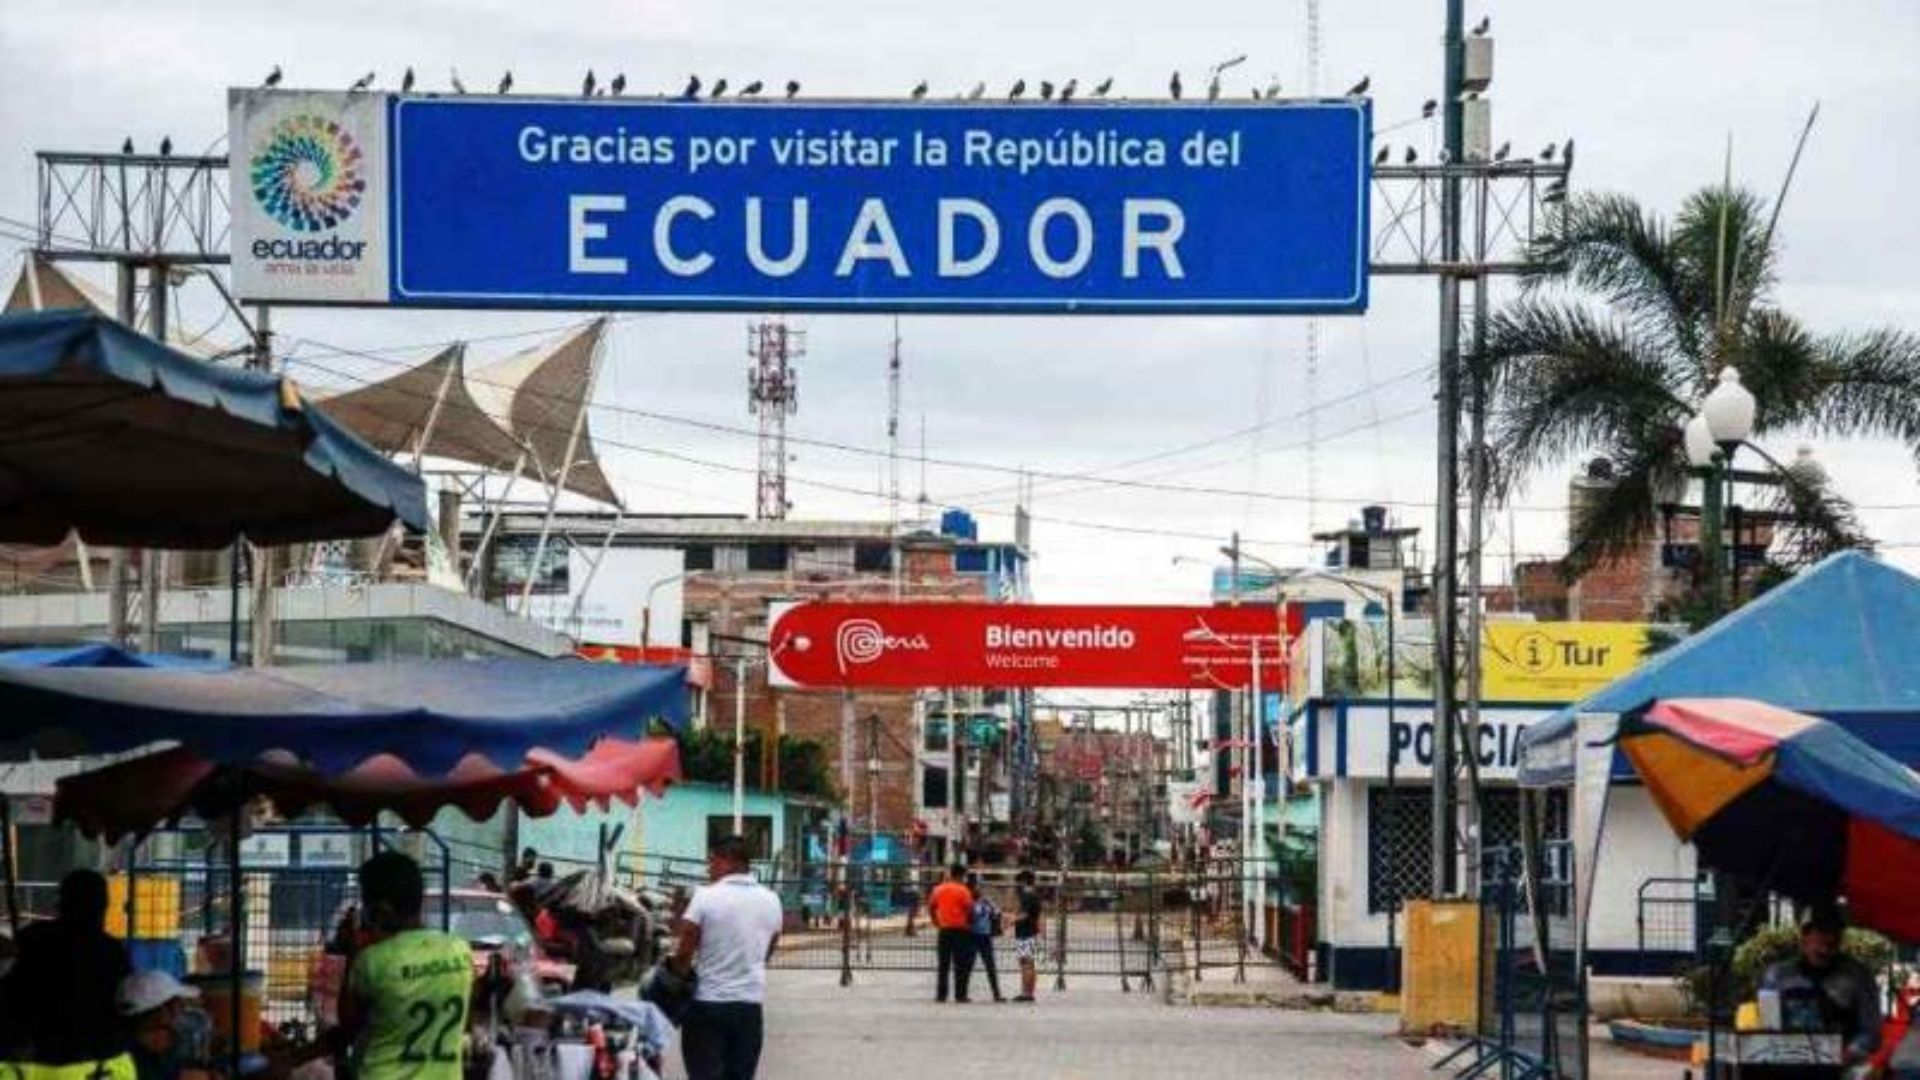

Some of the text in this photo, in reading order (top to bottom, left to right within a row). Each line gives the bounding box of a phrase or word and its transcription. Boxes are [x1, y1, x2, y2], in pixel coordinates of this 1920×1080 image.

[519, 126, 1239, 174] Gracias por visitar la República del
[251, 234, 366, 260] ecuador
[570, 195, 1185, 278] ECUADOR
[985, 624, 1135, 648] Bienvenido
[1556, 640, 1611, 666] Tur
[986, 653, 1059, 668] Welcome
[1390, 721, 1525, 767] POICI
[401, 996, 464, 1062] 22
